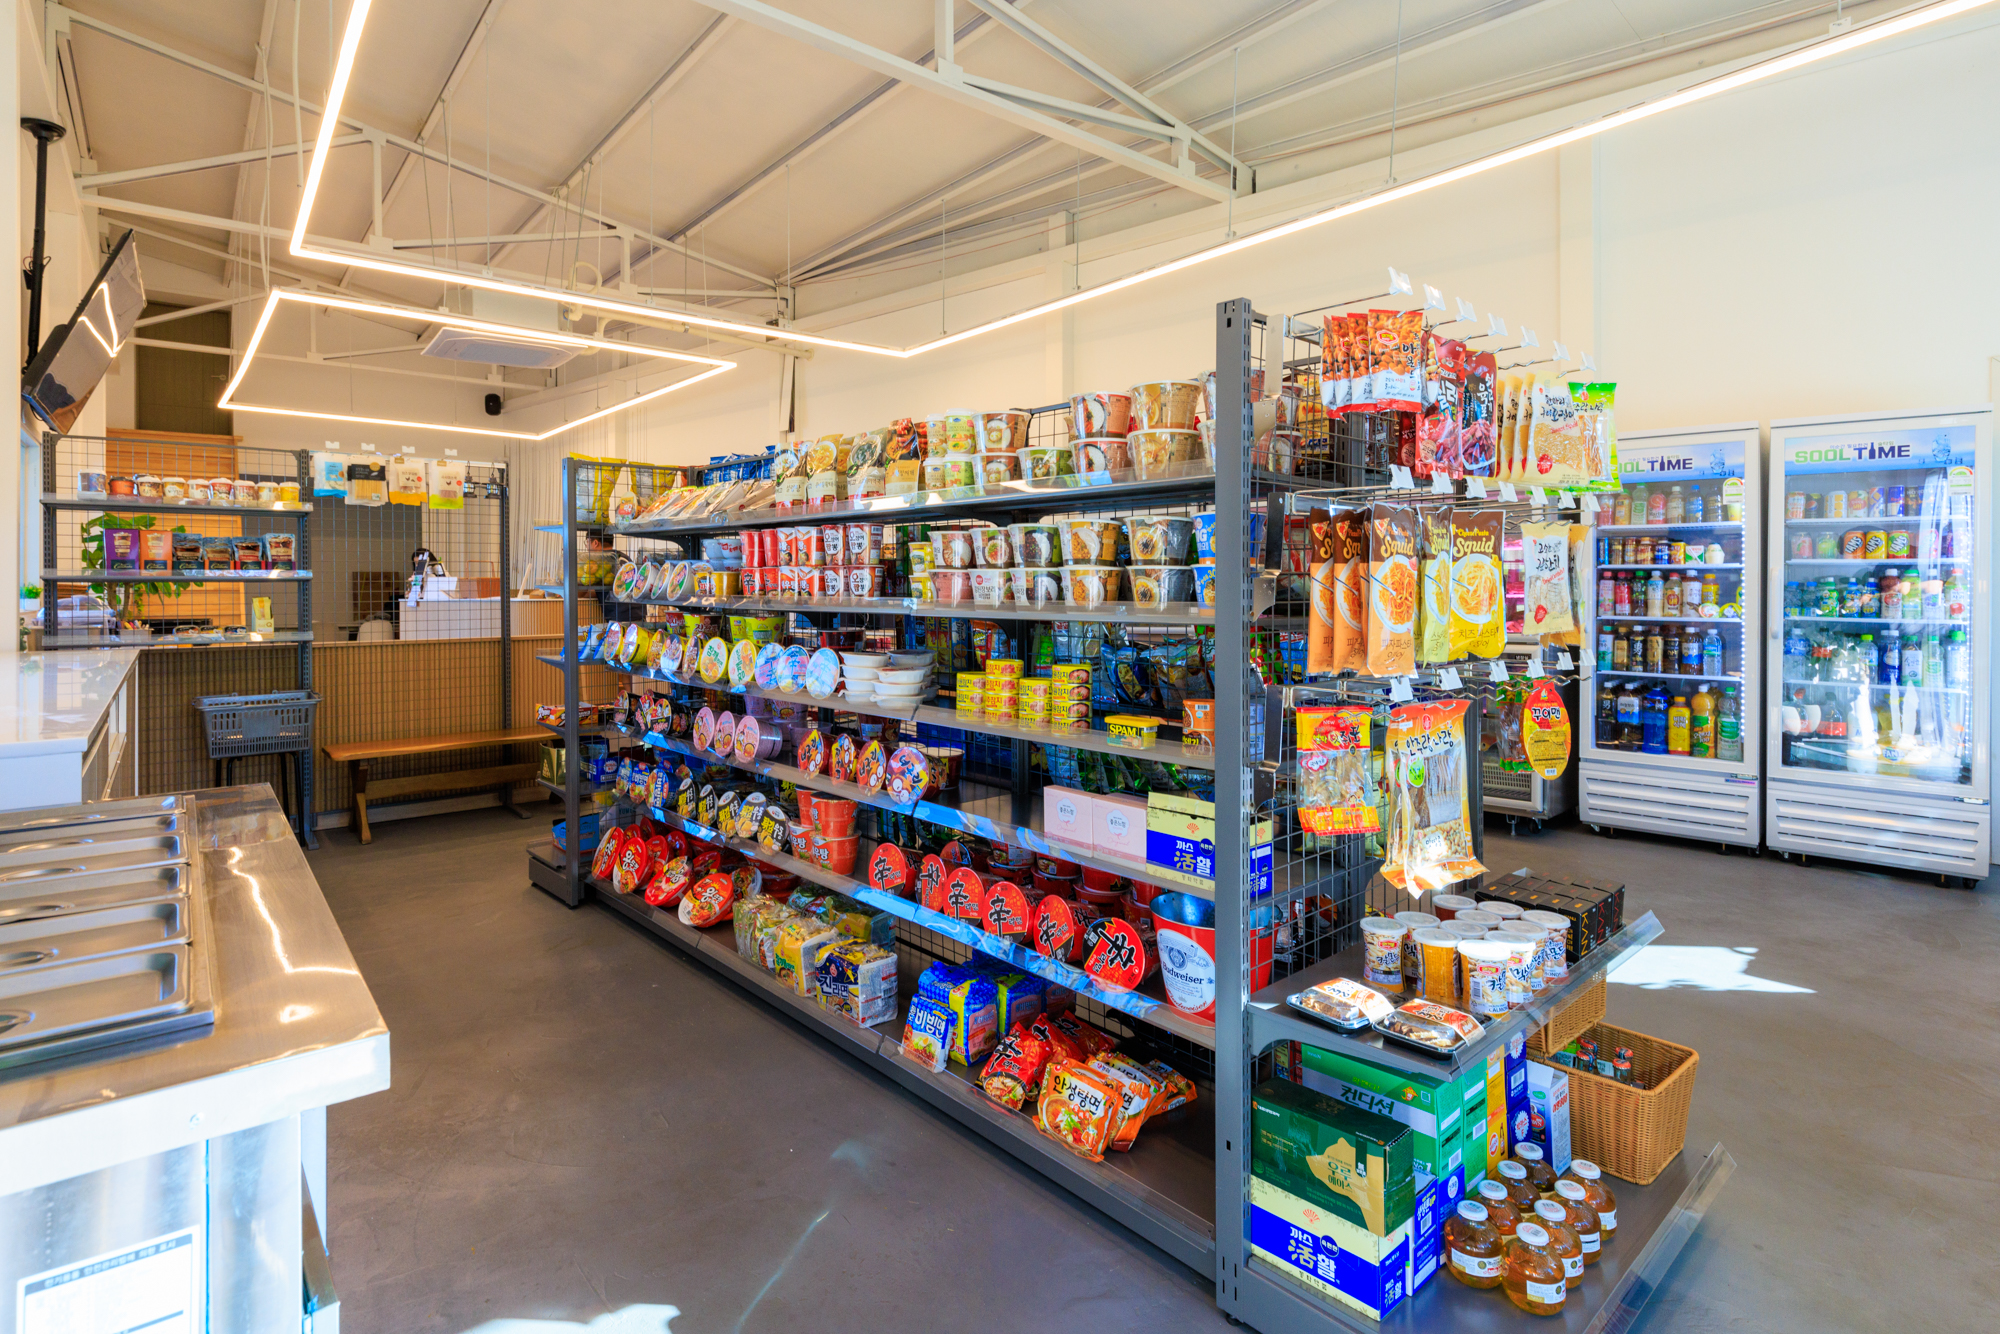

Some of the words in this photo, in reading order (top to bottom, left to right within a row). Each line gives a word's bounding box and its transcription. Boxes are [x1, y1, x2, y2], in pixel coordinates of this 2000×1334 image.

[1647, 456, 1693, 472] TIME
[1795, 448, 1850, 464] SOOL
[1853, 442, 1911, 460] TIME
[1196, 528, 1207, 543] IG
[1381, 536, 1414, 558] Squid
[1453, 535, 1495, 558] Squid
[1109, 724, 1136, 737] SPAM
[1175, 840, 1194, 853] 까스
[874, 855, 892, 892] 辛
[1196, 856, 1212, 876] 활
[948, 879, 969, 920] 辛
[965, 902, 979, 912] 라면
[989, 895, 1011, 938] 辛
[1008, 915, 1023, 926] 라면
[1039, 913, 1057, 960] 辛
[1099, 928, 1136, 970] 辛
[1162, 960, 1204, 986] Budweiser
[1054, 1074, 1102, 1116] 안성탕면
[1340, 1084, 1395, 1119] 컨디션
[1290, 1226, 1314, 1247] 까스
[1288, 1239, 1317, 1270] 活
[1317, 1253, 1337, 1283] 활
